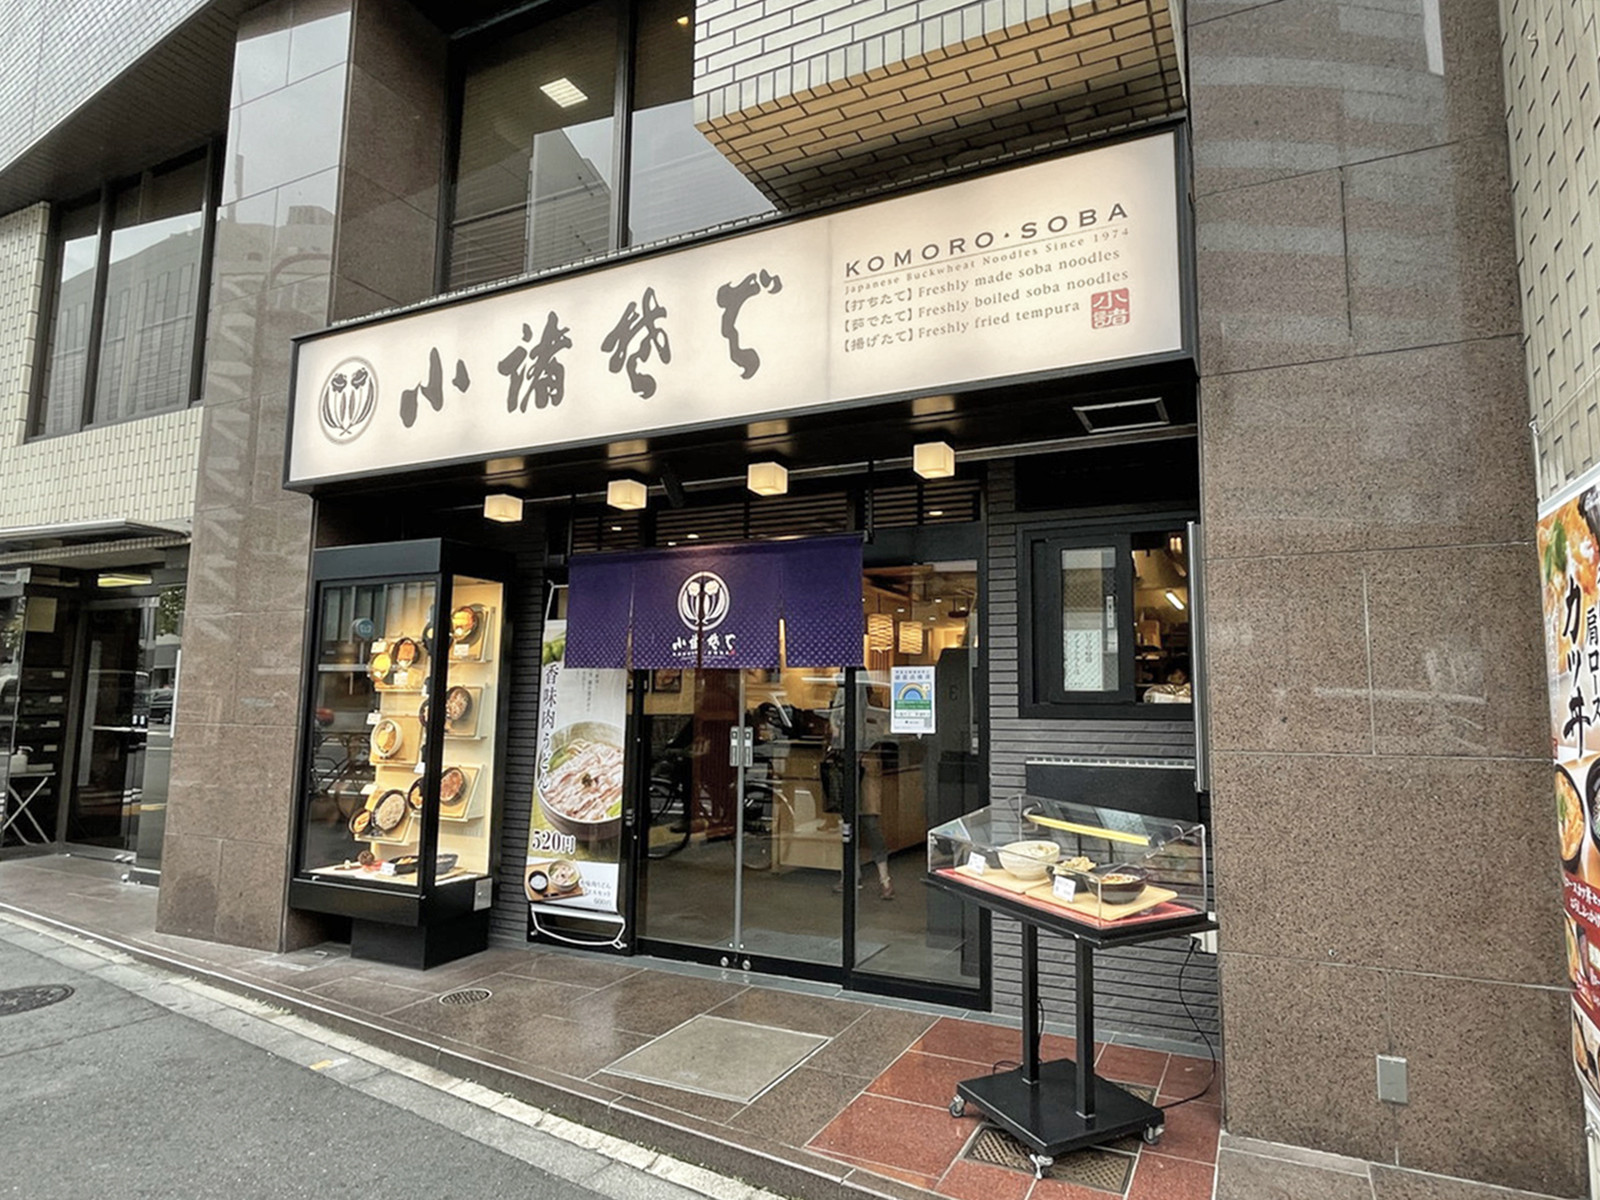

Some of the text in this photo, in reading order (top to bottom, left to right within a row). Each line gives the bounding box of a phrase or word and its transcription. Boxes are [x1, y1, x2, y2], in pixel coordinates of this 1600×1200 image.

[844, 227, 1129, 295] Japanese Buckwheat Noodles Since 1974
[918, 280, 969, 298] Freshly
[975, 270, 1013, 287] made
[1018, 263, 1052, 279] soba
[1058, 249, 1120, 270] noodles
[918, 300, 969, 318] Freshly
[975, 289, 1020, 308] boiled
[1026, 283, 1060, 298] soba
[1067, 270, 1129, 290] noodles
[918, 320, 969, 339] Freshly
[975, 312, 1010, 329] fried
[1016, 301, 1081, 321] tempura
[1563, 574, 1592, 759] カツ丼
[539, 664, 559, 790] 香味肉うどん
[532, 830, 576, 853] 520円
